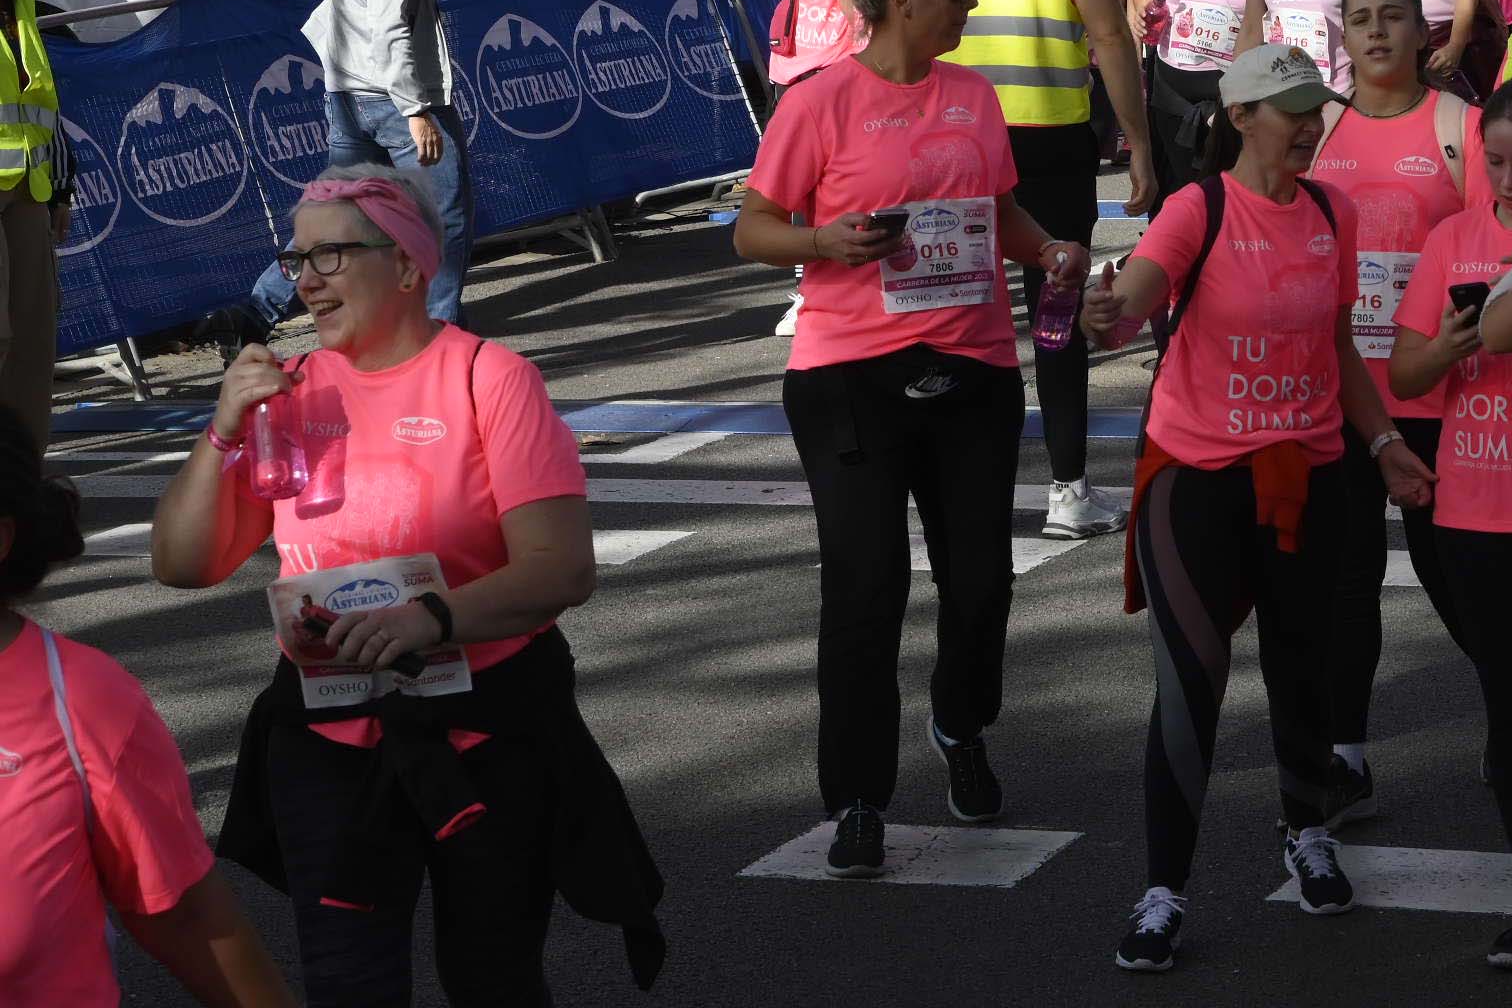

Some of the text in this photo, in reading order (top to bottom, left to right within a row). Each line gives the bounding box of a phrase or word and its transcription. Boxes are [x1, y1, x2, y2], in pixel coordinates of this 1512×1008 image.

[1195, 26, 1221, 41] 016
[1285, 36, 1308, 48] 016
[581, 47, 668, 93] ASTURIANA
[486, 65, 579, 113] ASTURIANA
[863, 118, 909, 132] OYSHO
[130, 139, 241, 199] ASTURIANA
[1397, 161, 1435, 173] ASTURIANA
[914, 219, 956, 230] ASTURIANA
[920, 241, 959, 259] 016
[929, 261, 954, 273] 7806
[1452, 261, 1499, 274] OYSHO
[895, 293, 932, 306] OYSHO
[1352, 294, 1383, 310] 16
[1352, 312, 1375, 323] 7805
[1360, 327, 1369, 335] LA
[1369, 327, 1394, 336] MUJER
[1227, 335, 1266, 363] TU
[303, 421, 352, 437] YSHO
[393, 423, 443, 437] ASTURIANA
[280, 543, 318, 573] TU
[403, 577, 435, 588] SUMA
[330, 590, 395, 611] ASTURIANA
[318, 680, 369, 696] OYSHO
